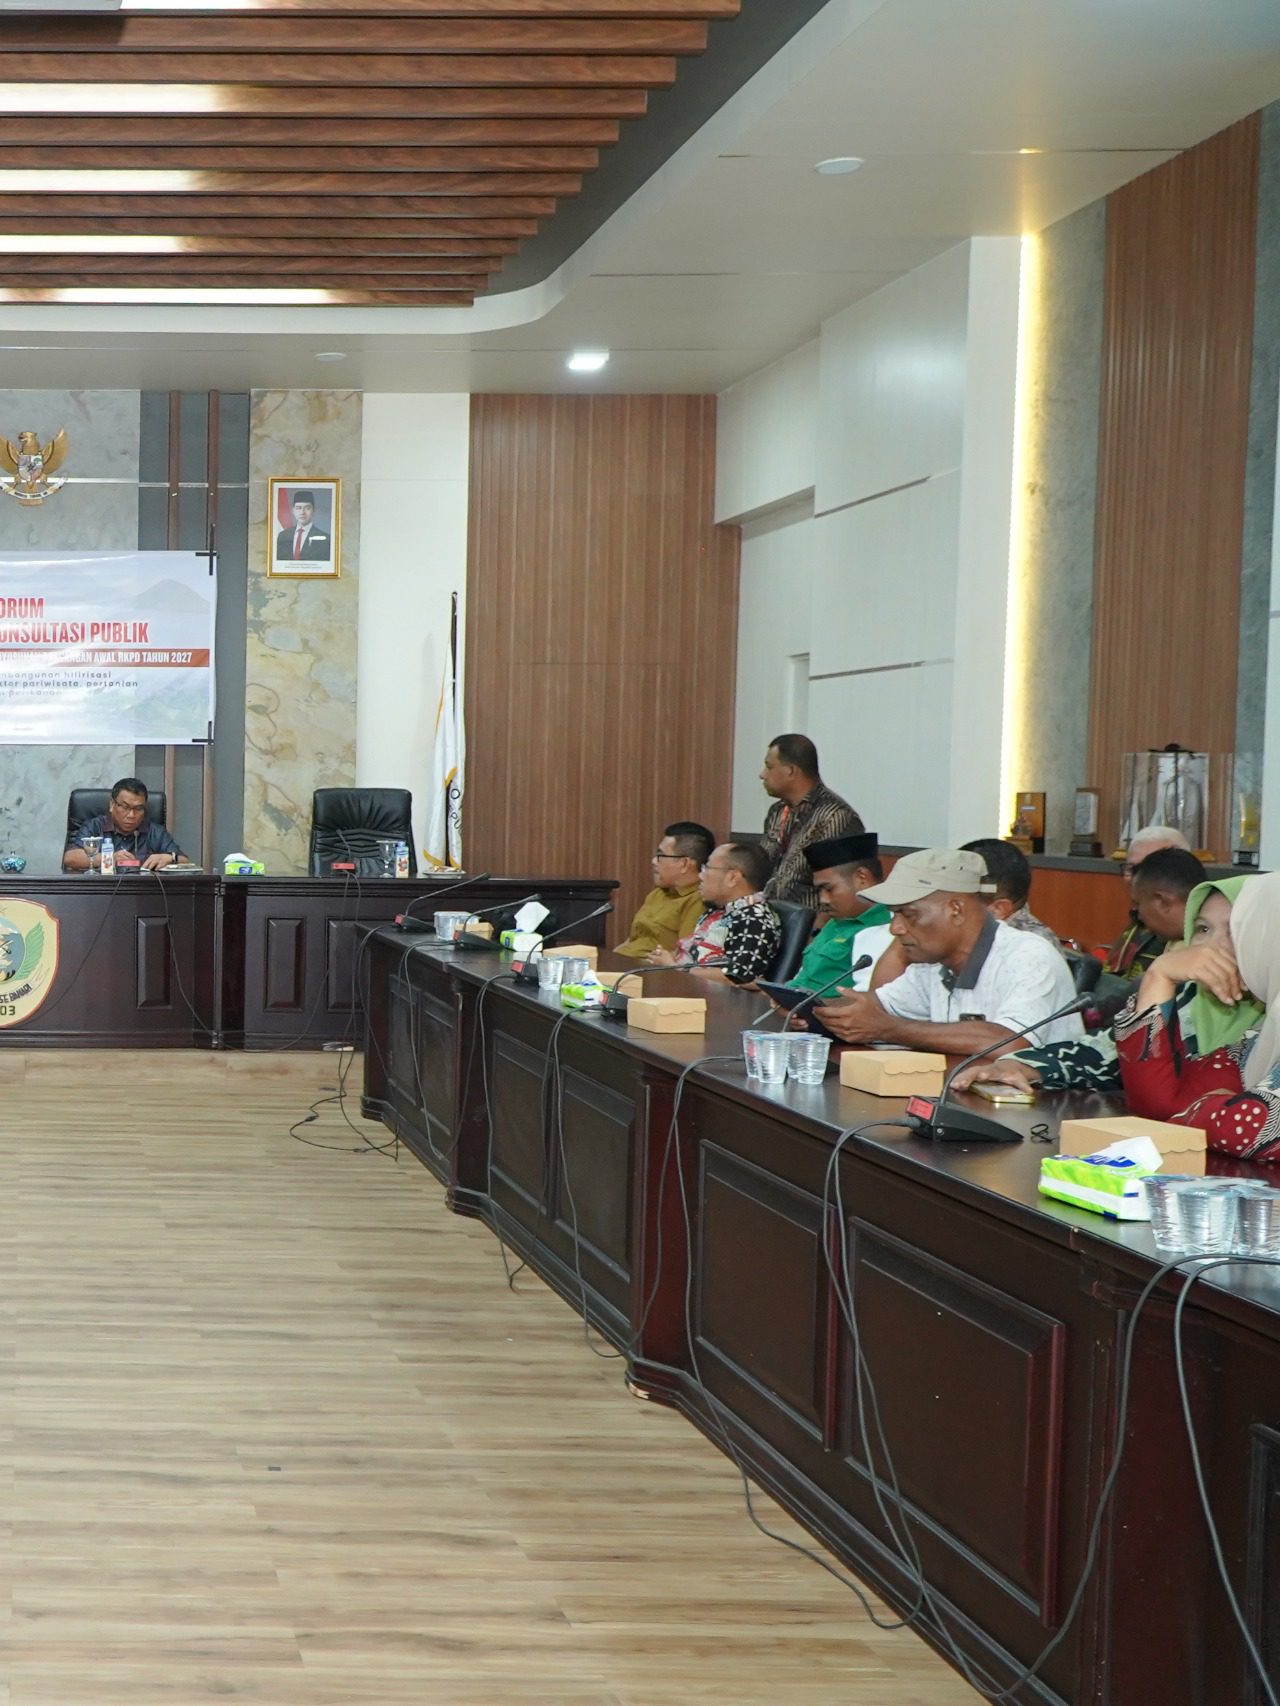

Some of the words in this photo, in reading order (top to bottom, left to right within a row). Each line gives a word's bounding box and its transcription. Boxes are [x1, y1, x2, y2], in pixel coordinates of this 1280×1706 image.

[90, 622, 149, 643] PUBLIK
[94, 651, 118, 663] AWAL
[118, 651, 140, 663] RKPD
[142, 651, 170, 663] TAHUN
[171, 651, 193, 663] 2027
[87, 680, 138, 688] pertanian
[0, 993, 9, 1003] SE
